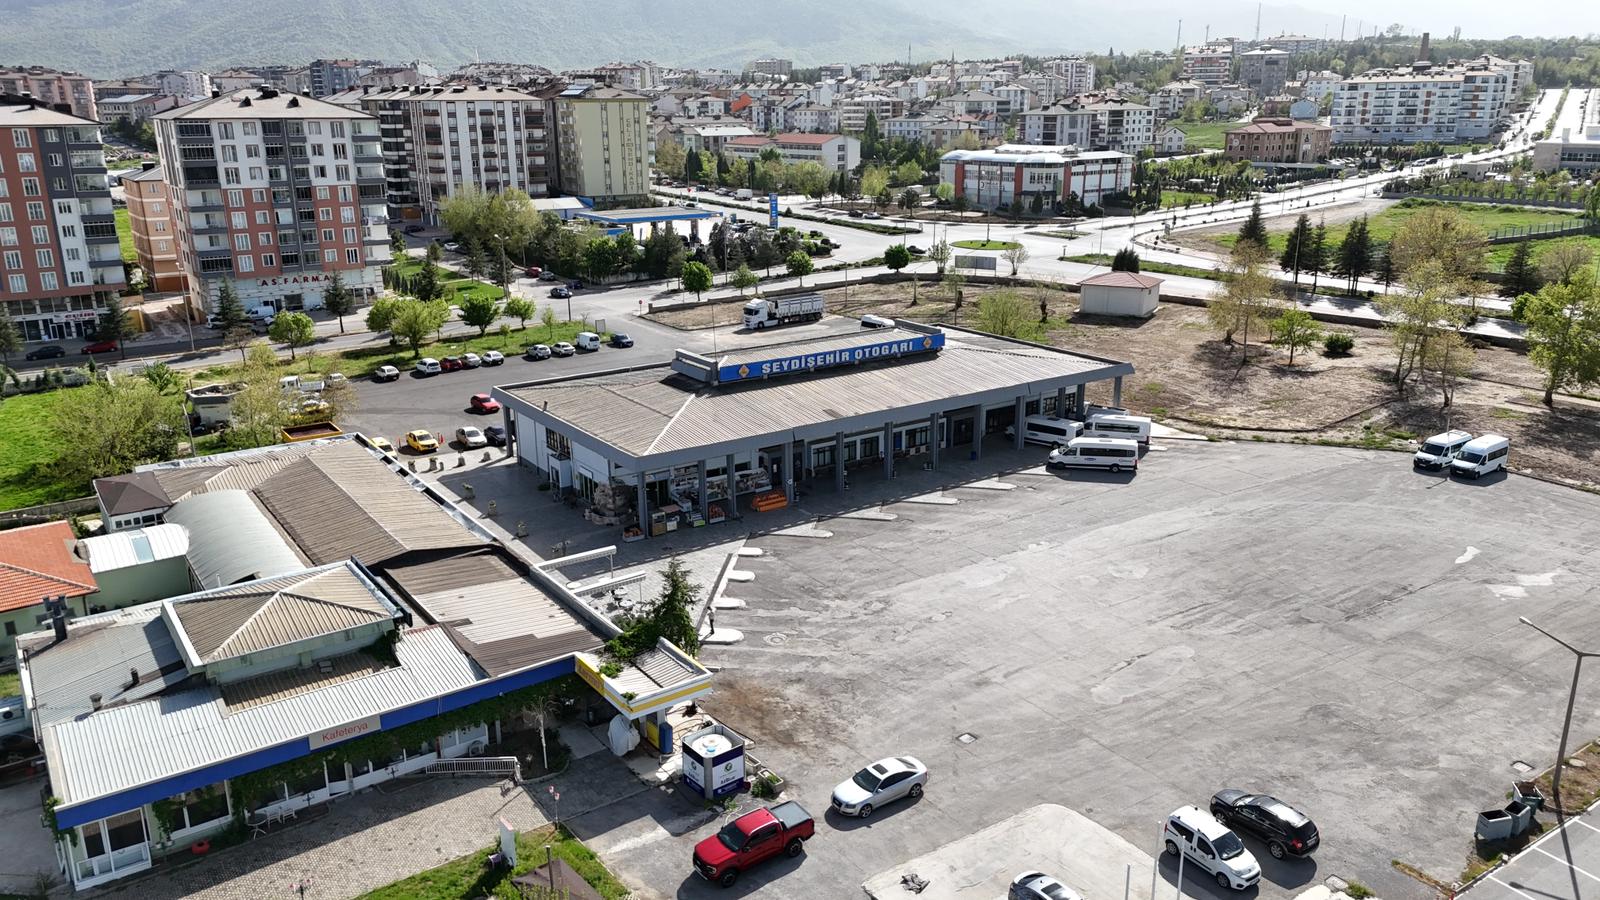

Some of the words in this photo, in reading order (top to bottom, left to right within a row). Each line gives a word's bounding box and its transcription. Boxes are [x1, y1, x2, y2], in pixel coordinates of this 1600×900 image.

[283, 274, 331, 285] FARMA
[761, 351, 850, 375] SEYDİŞEHİR
[855, 341, 913, 360] OTOGARI
[322, 722, 368, 742] Kafeterya
